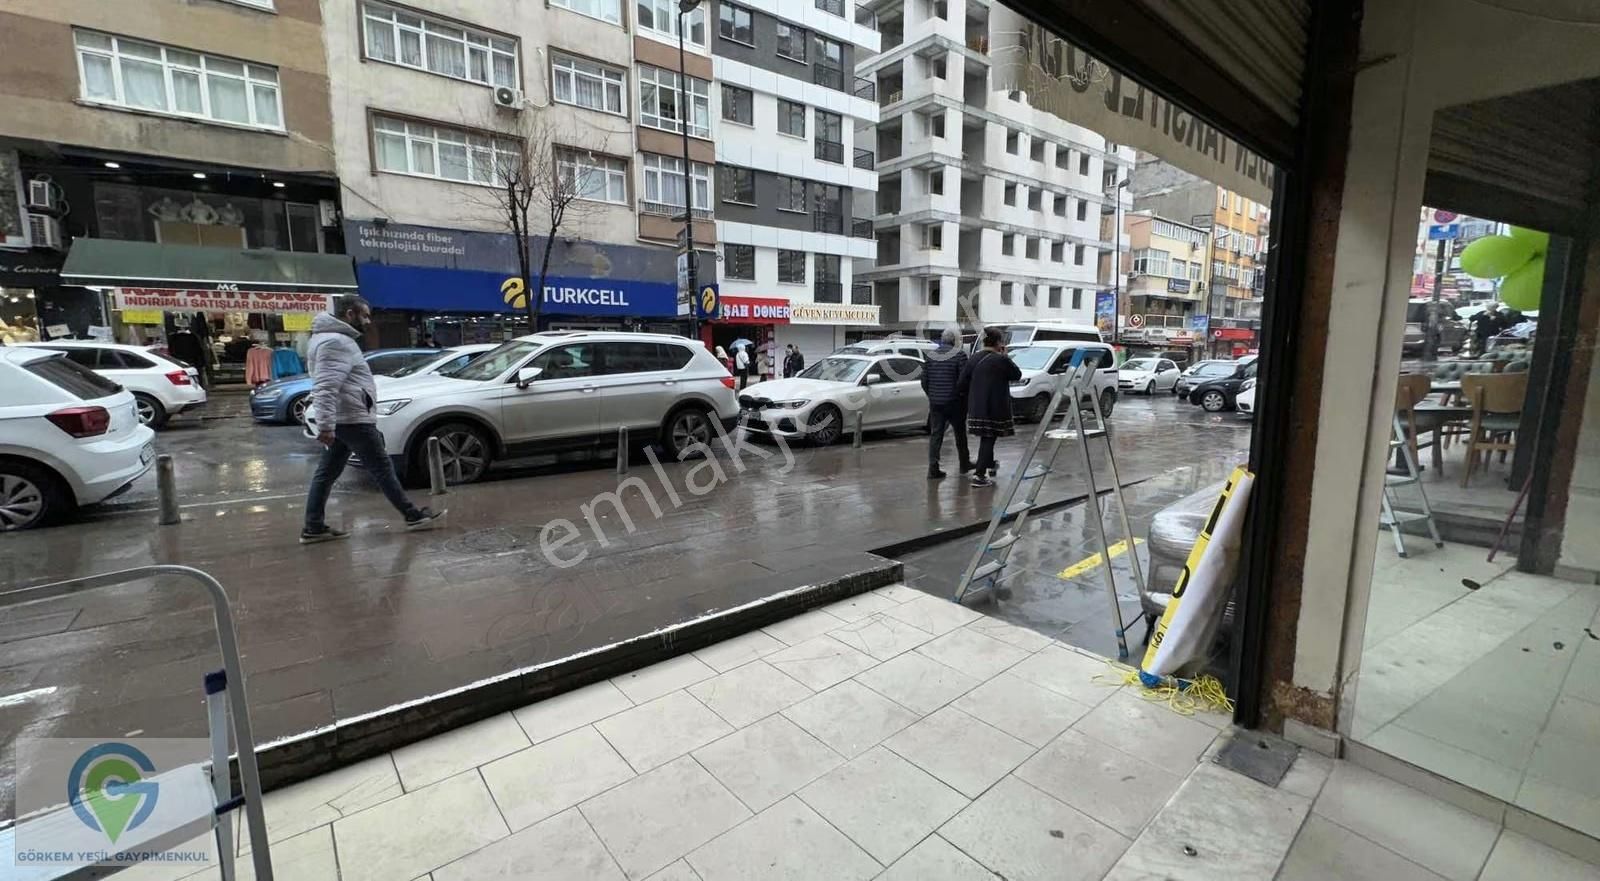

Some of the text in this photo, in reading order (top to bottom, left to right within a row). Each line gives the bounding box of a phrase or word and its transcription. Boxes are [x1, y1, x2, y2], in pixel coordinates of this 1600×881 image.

[382, 228, 425, 241] hızında
[427, 232, 452, 243] fiber
[360, 238, 465, 255] teknolojisi burada!
[217, 283, 239, 291] MG
[543, 286, 630, 306] TURKCELL
[190, 298, 249, 310] SATIŞLAR
[723, 304, 750, 319] ŞAH
[793, 306, 876, 320] GÜVEN KUYUMCULUK
